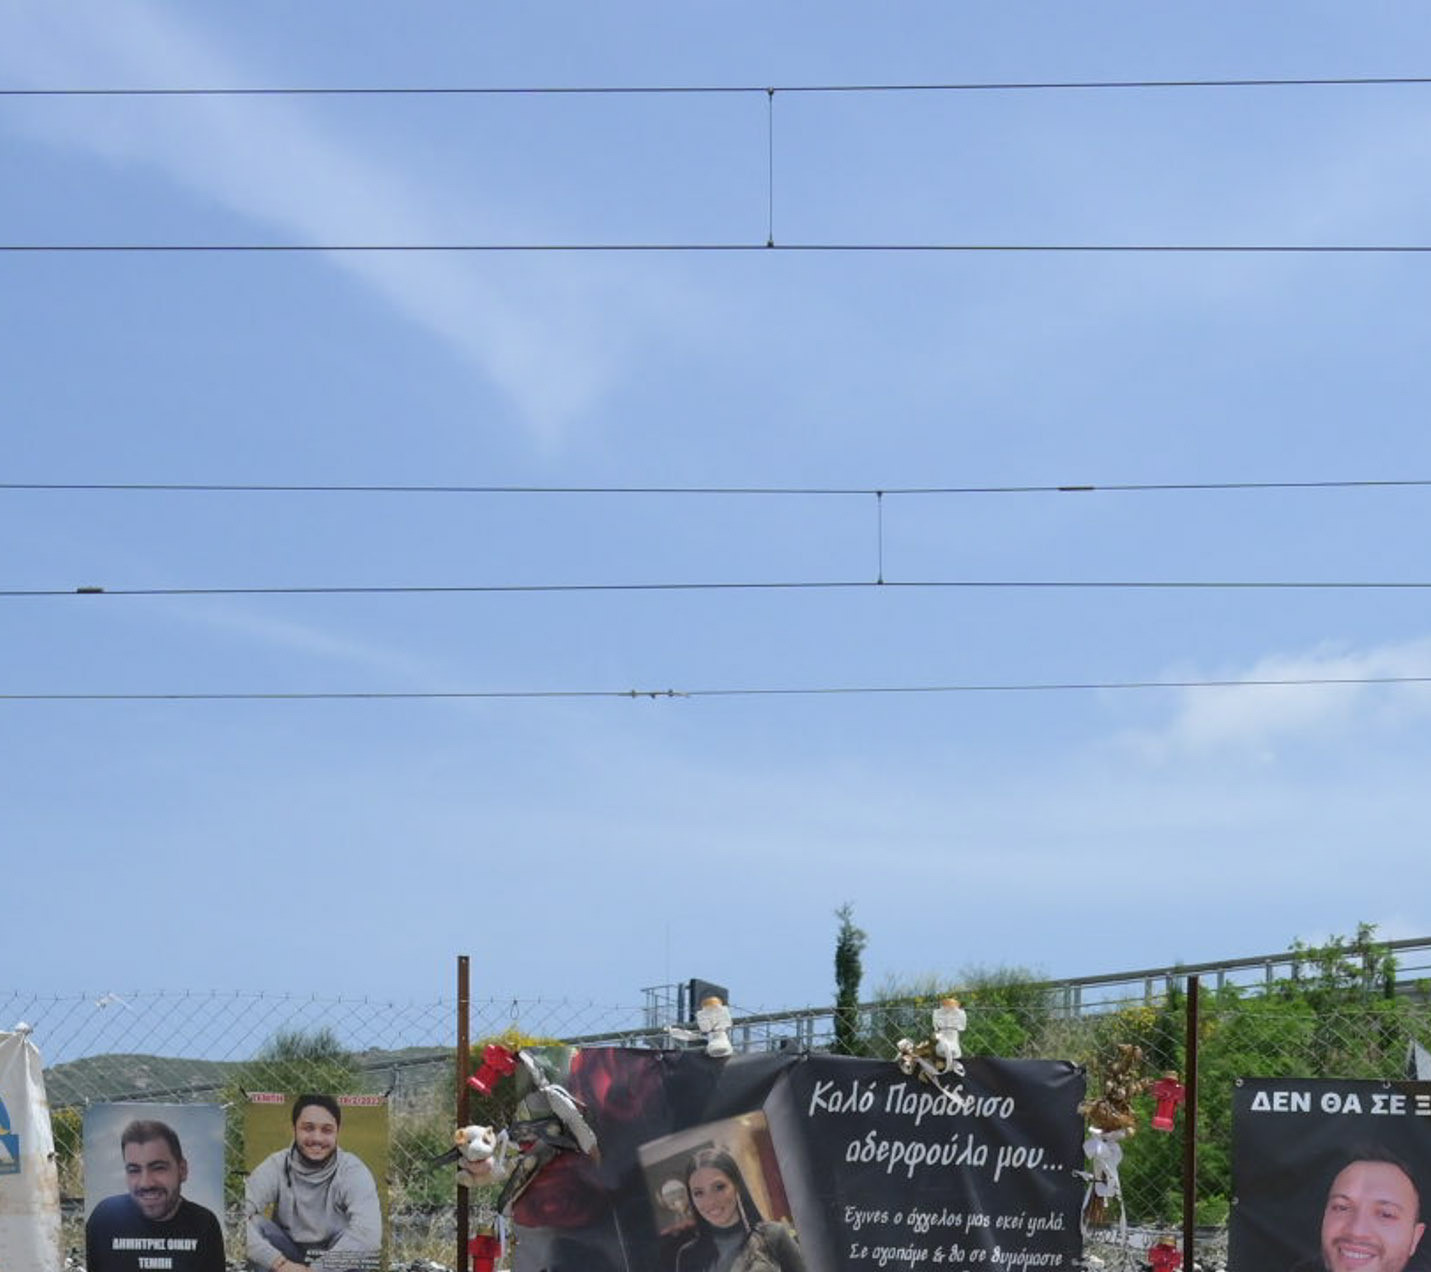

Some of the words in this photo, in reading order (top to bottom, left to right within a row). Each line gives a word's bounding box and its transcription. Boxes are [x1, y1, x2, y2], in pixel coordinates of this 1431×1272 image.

[808, 1080, 877, 1117] Καλό
[1250, 1091, 1313, 1114] ΔΕΝ
[1321, 1093, 1363, 1116] ΘΑ
[1371, 1093, 1407, 1117] ΣΕ
[845, 1130, 988, 1179] αδερφούλα
[993, 1146, 1063, 1182] μου...
